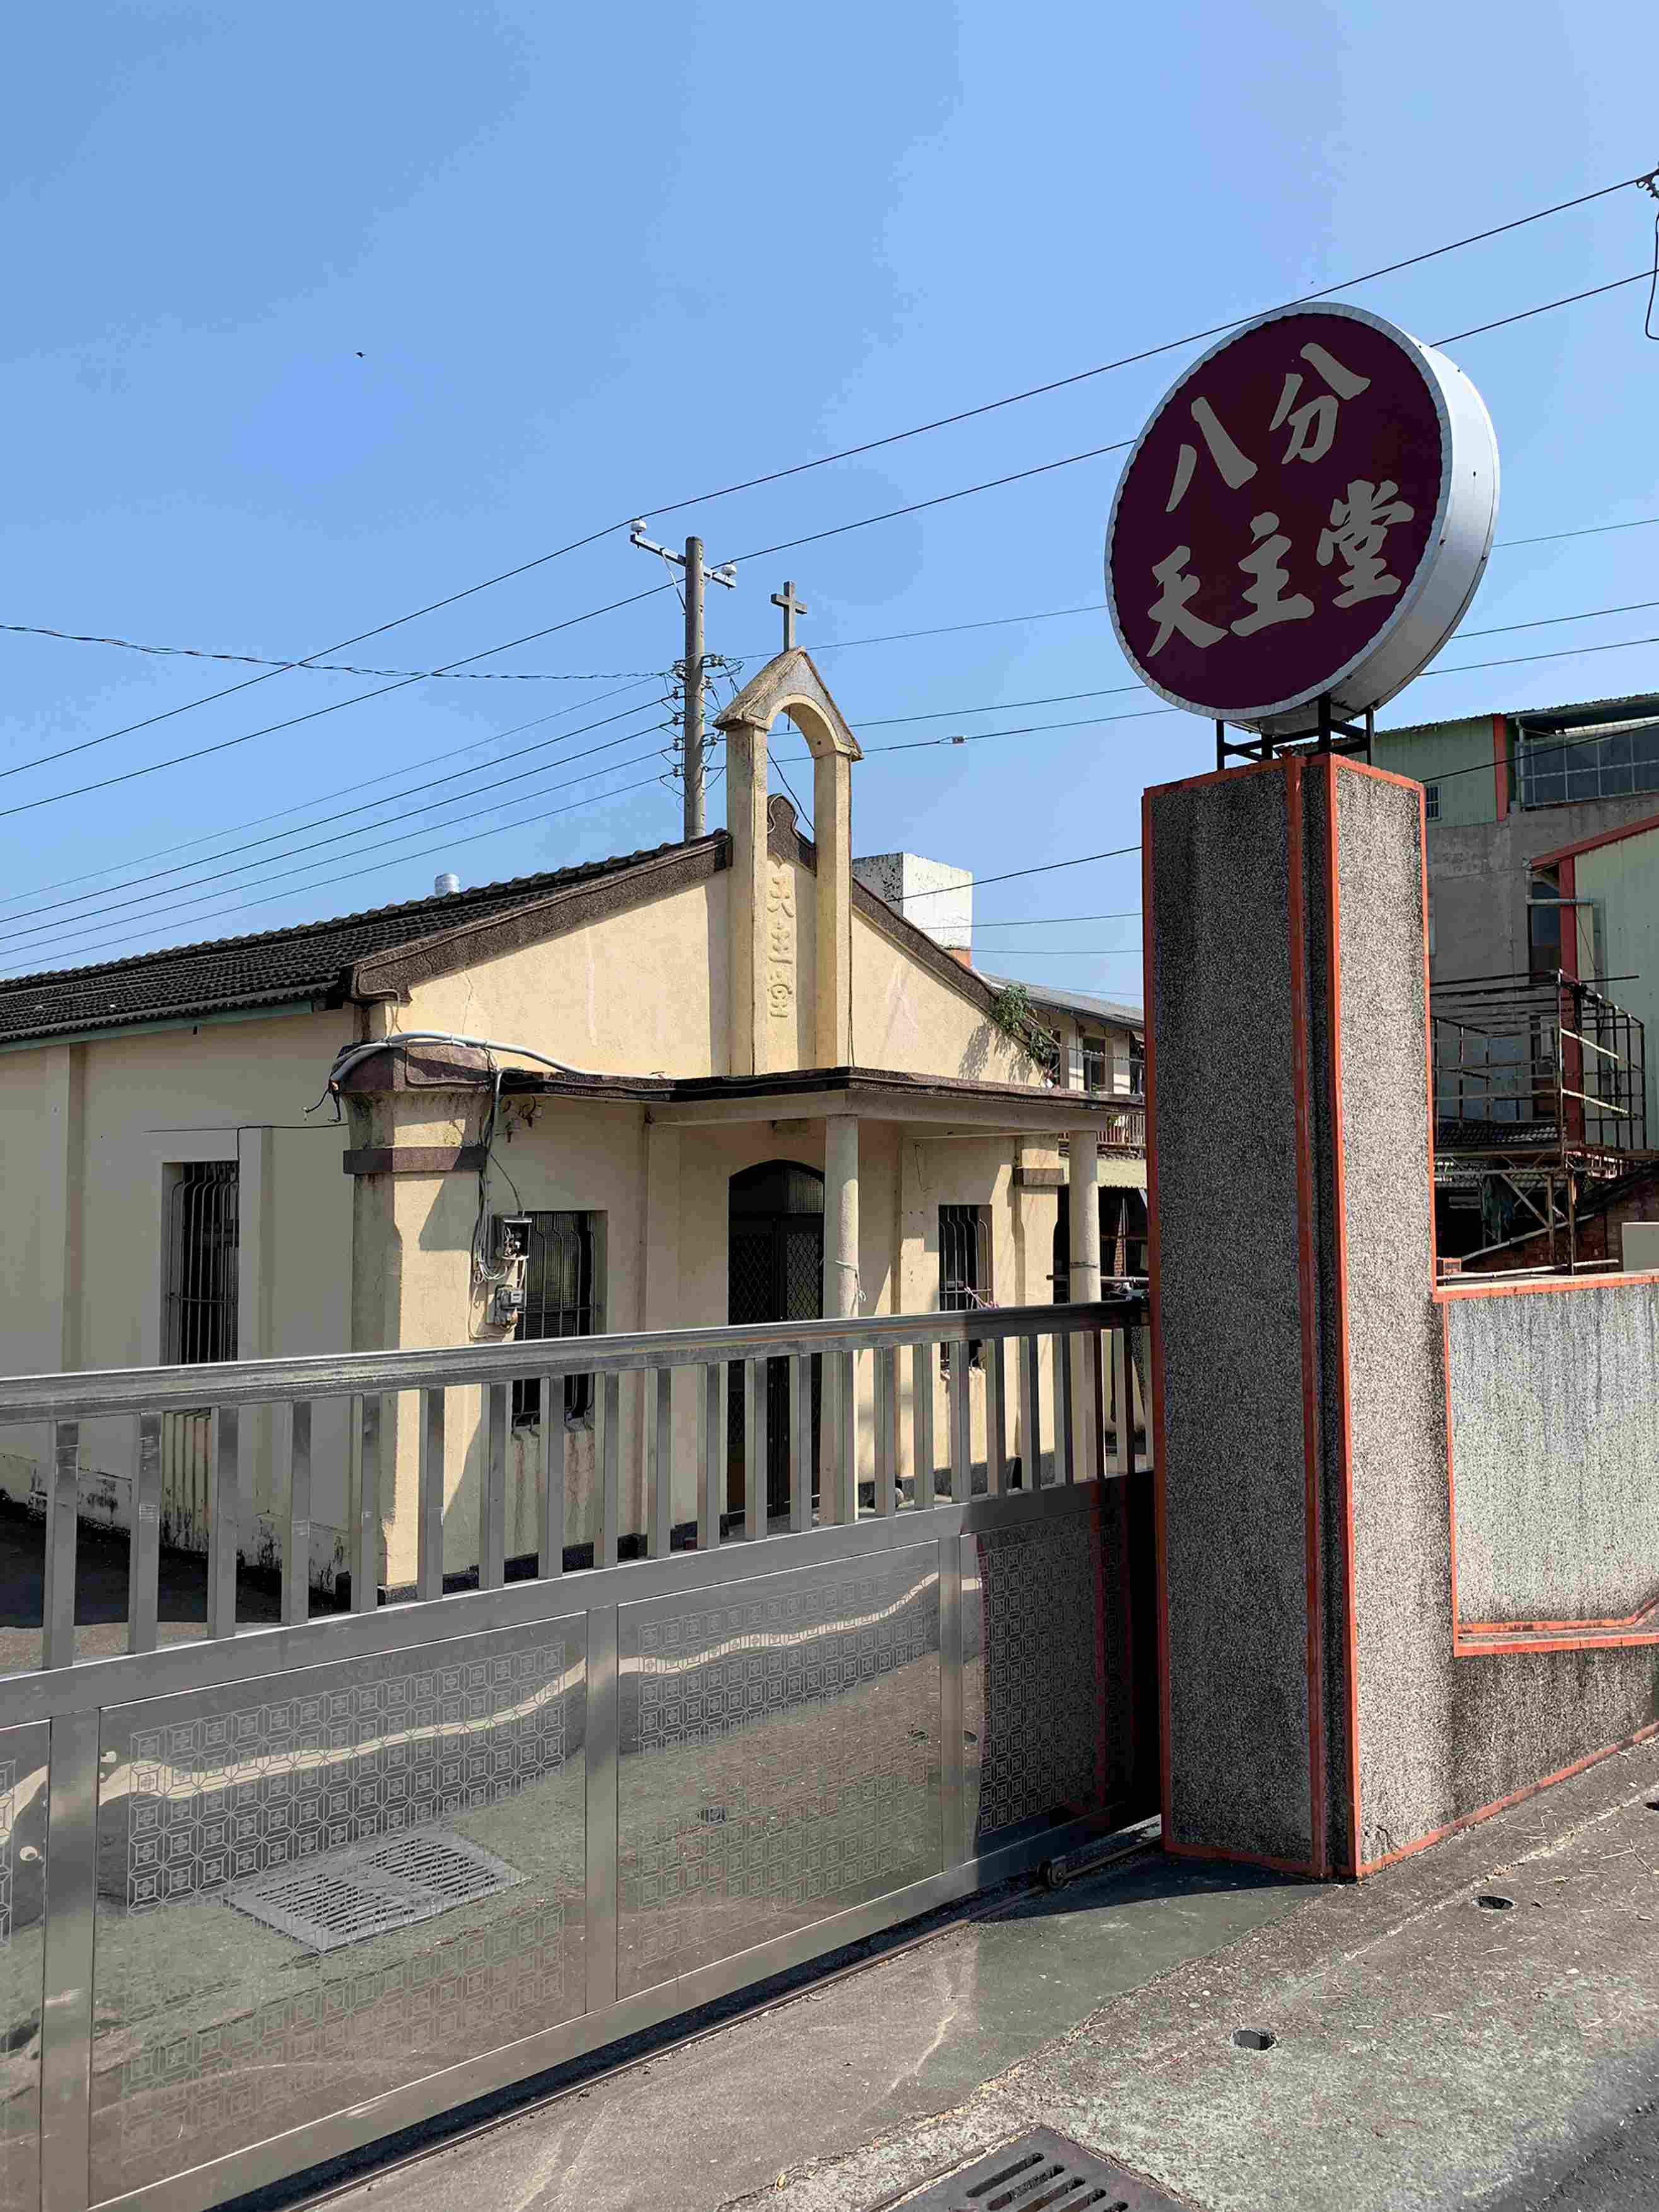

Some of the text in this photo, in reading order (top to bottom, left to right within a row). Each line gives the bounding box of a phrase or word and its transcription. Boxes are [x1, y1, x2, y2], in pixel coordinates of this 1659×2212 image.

[1165, 342, 1371, 513] 八分
[1146, 479, 1415, 658] 天主堂
[766, 875, 795, 1018] 天主堂
